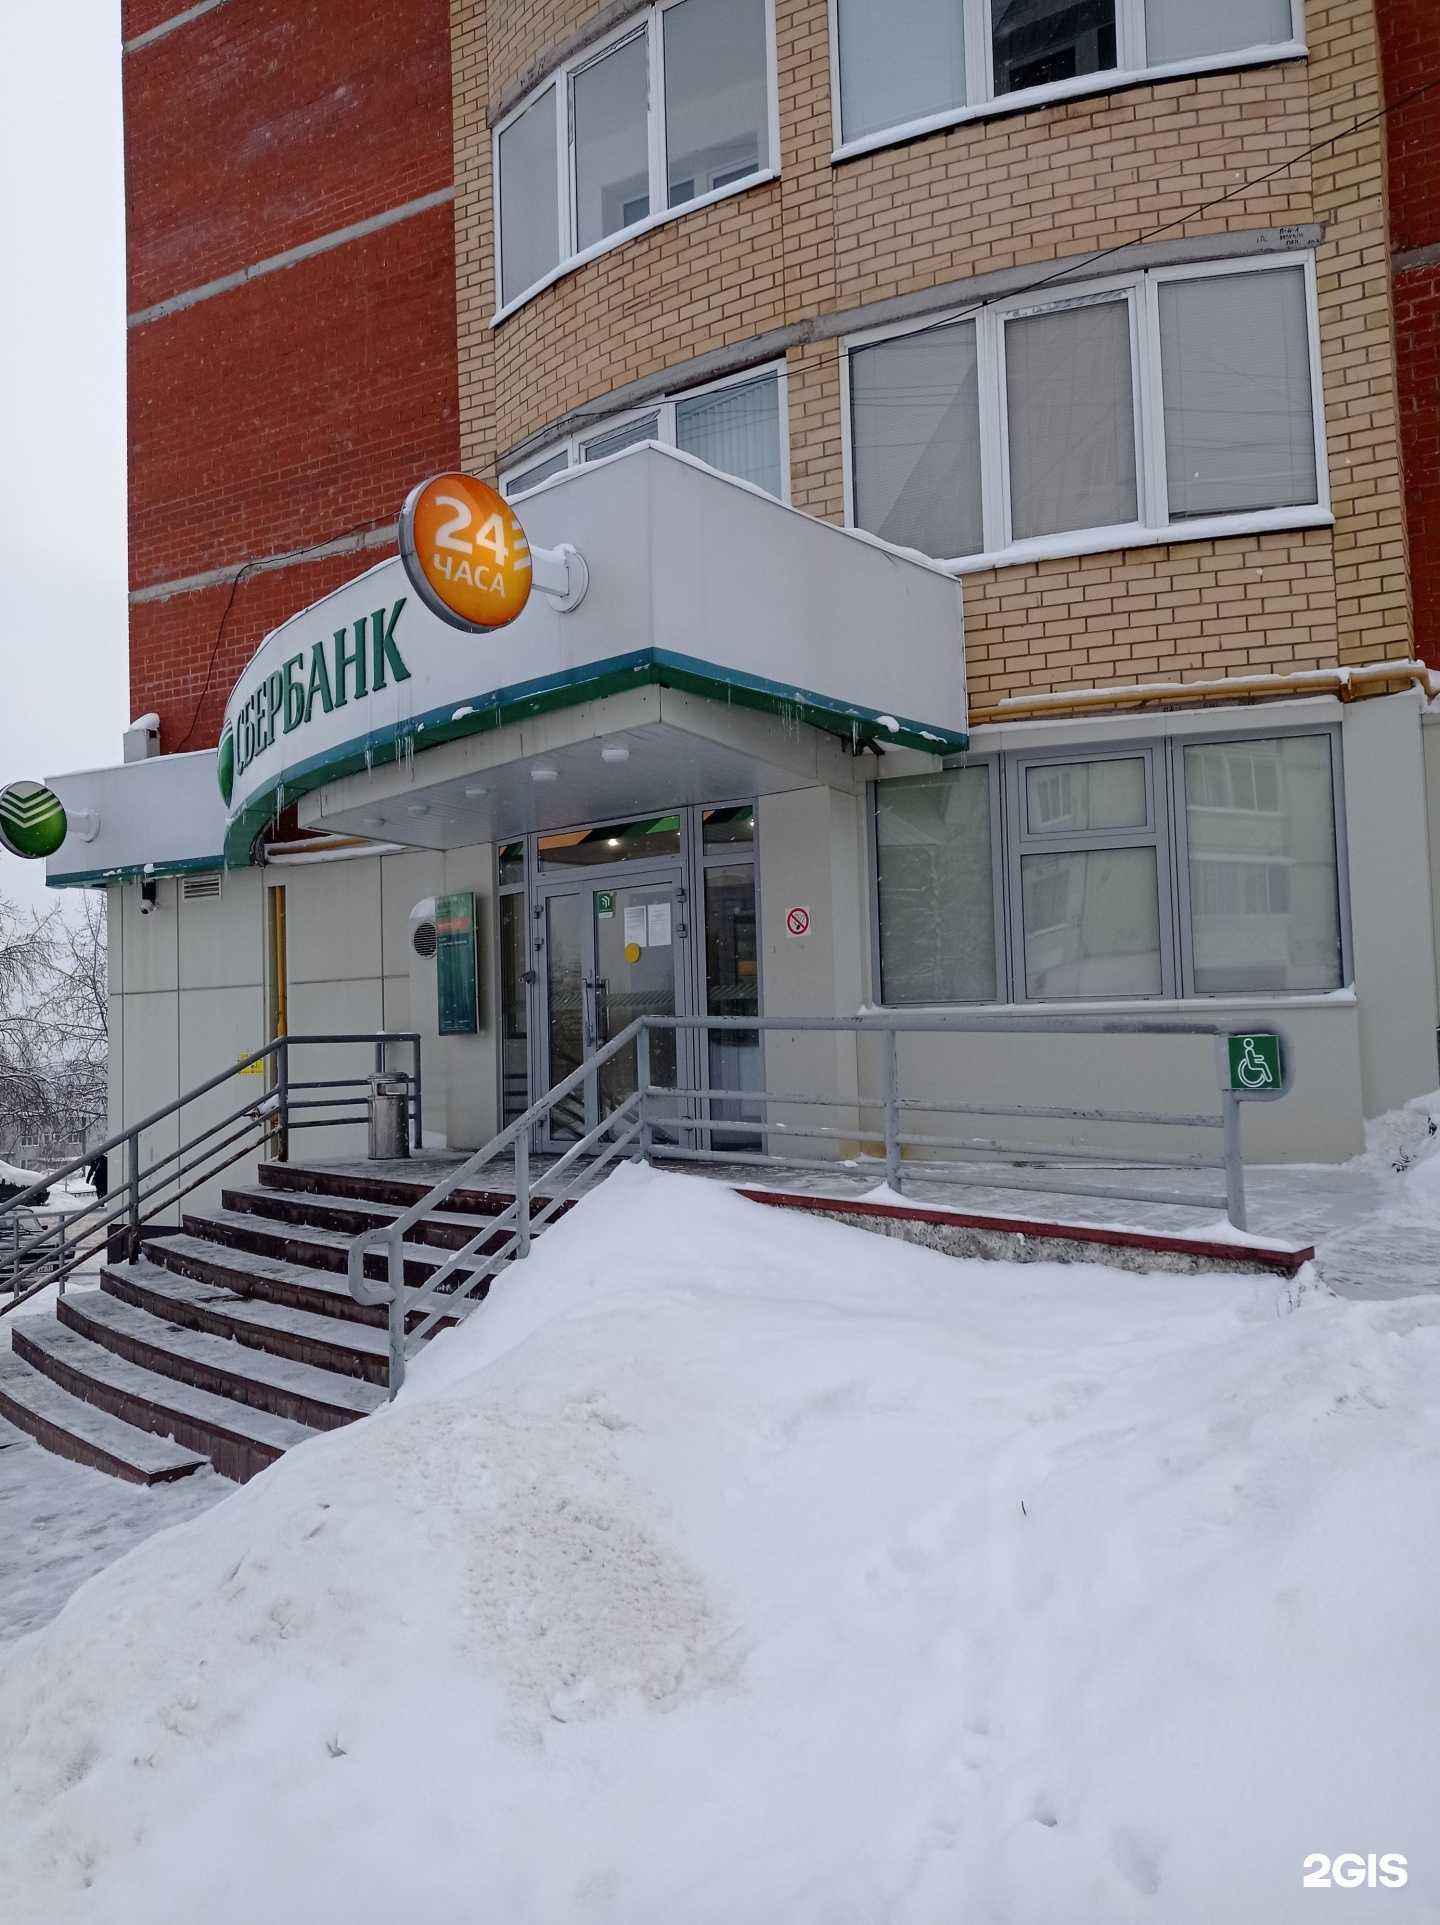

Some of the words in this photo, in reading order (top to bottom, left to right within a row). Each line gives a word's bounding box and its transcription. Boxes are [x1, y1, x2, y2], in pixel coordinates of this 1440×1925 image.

[434, 495, 510, 567] 24
[433, 553, 507, 599] ЧАСА
[234, 597, 411, 776] СБЕРБАНК
